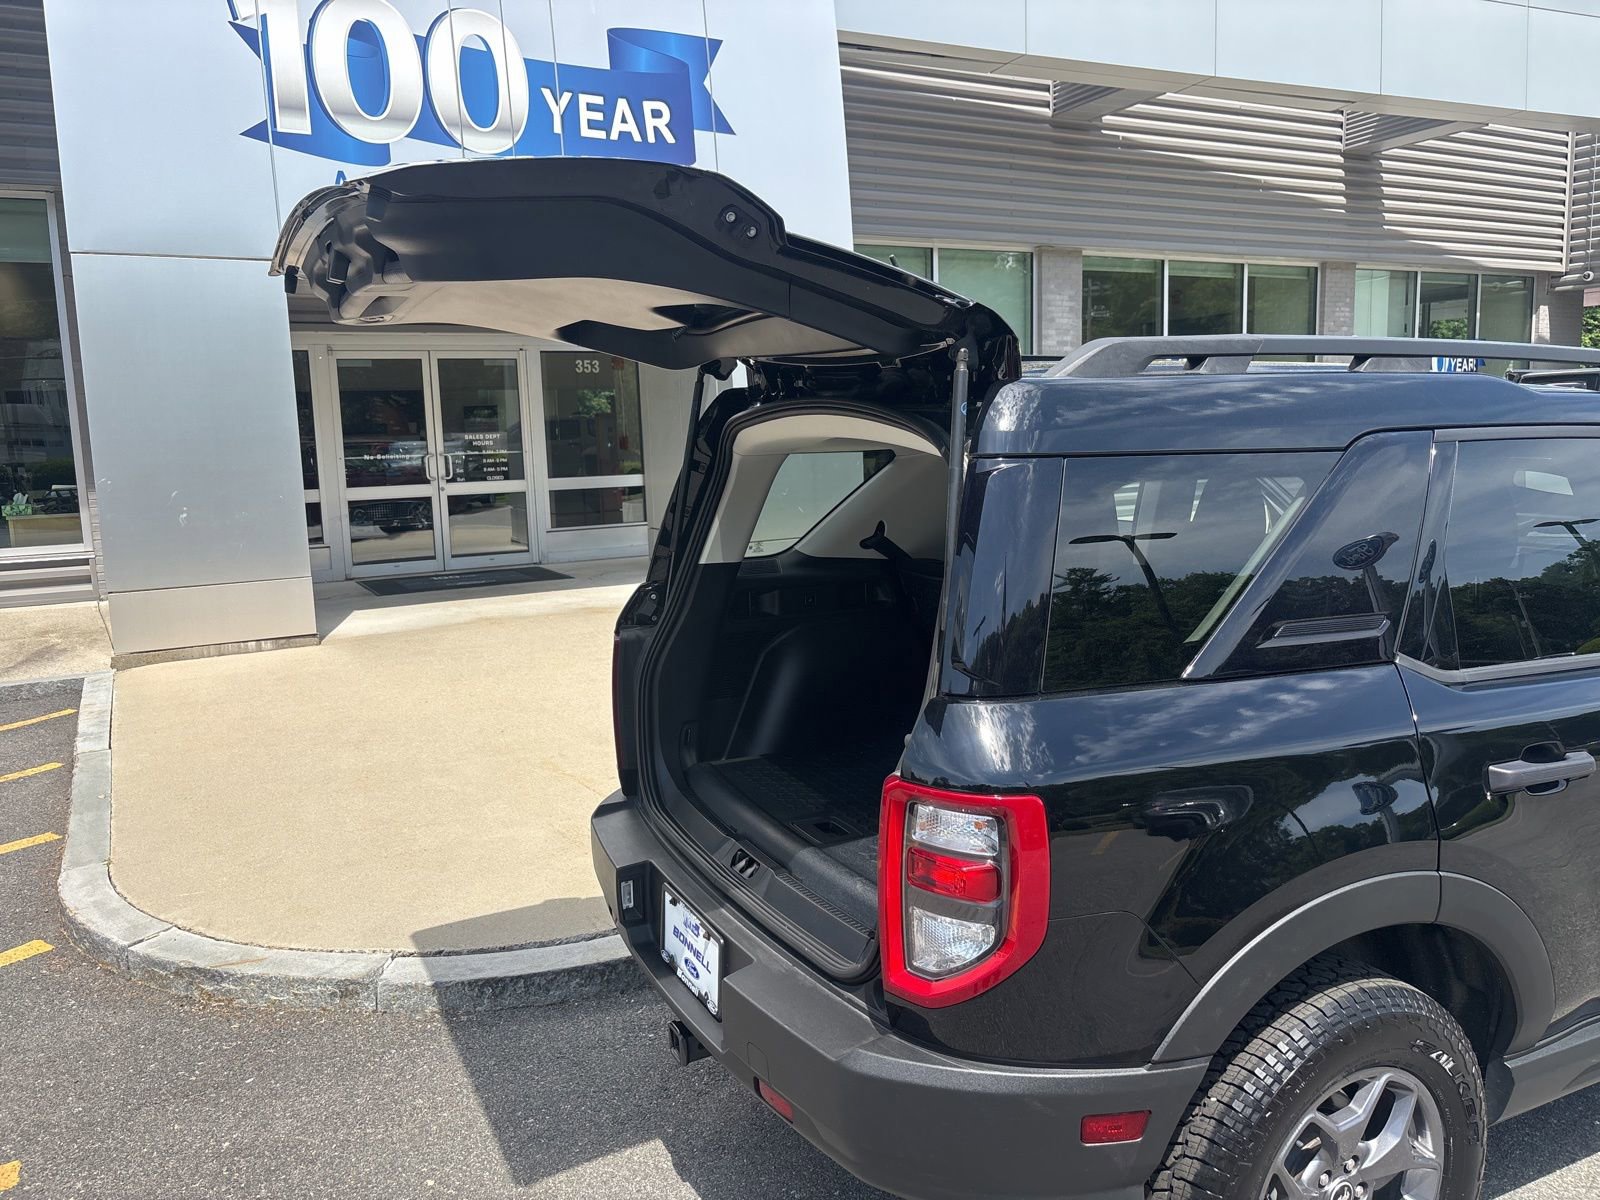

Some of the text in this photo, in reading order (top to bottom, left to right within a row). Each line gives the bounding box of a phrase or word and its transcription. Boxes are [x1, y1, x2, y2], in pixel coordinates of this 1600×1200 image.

[232, 0, 676, 153] 100 YEAR
[575, 360, 600, 374] 353
[672, 924, 712, 975] BONNELL
